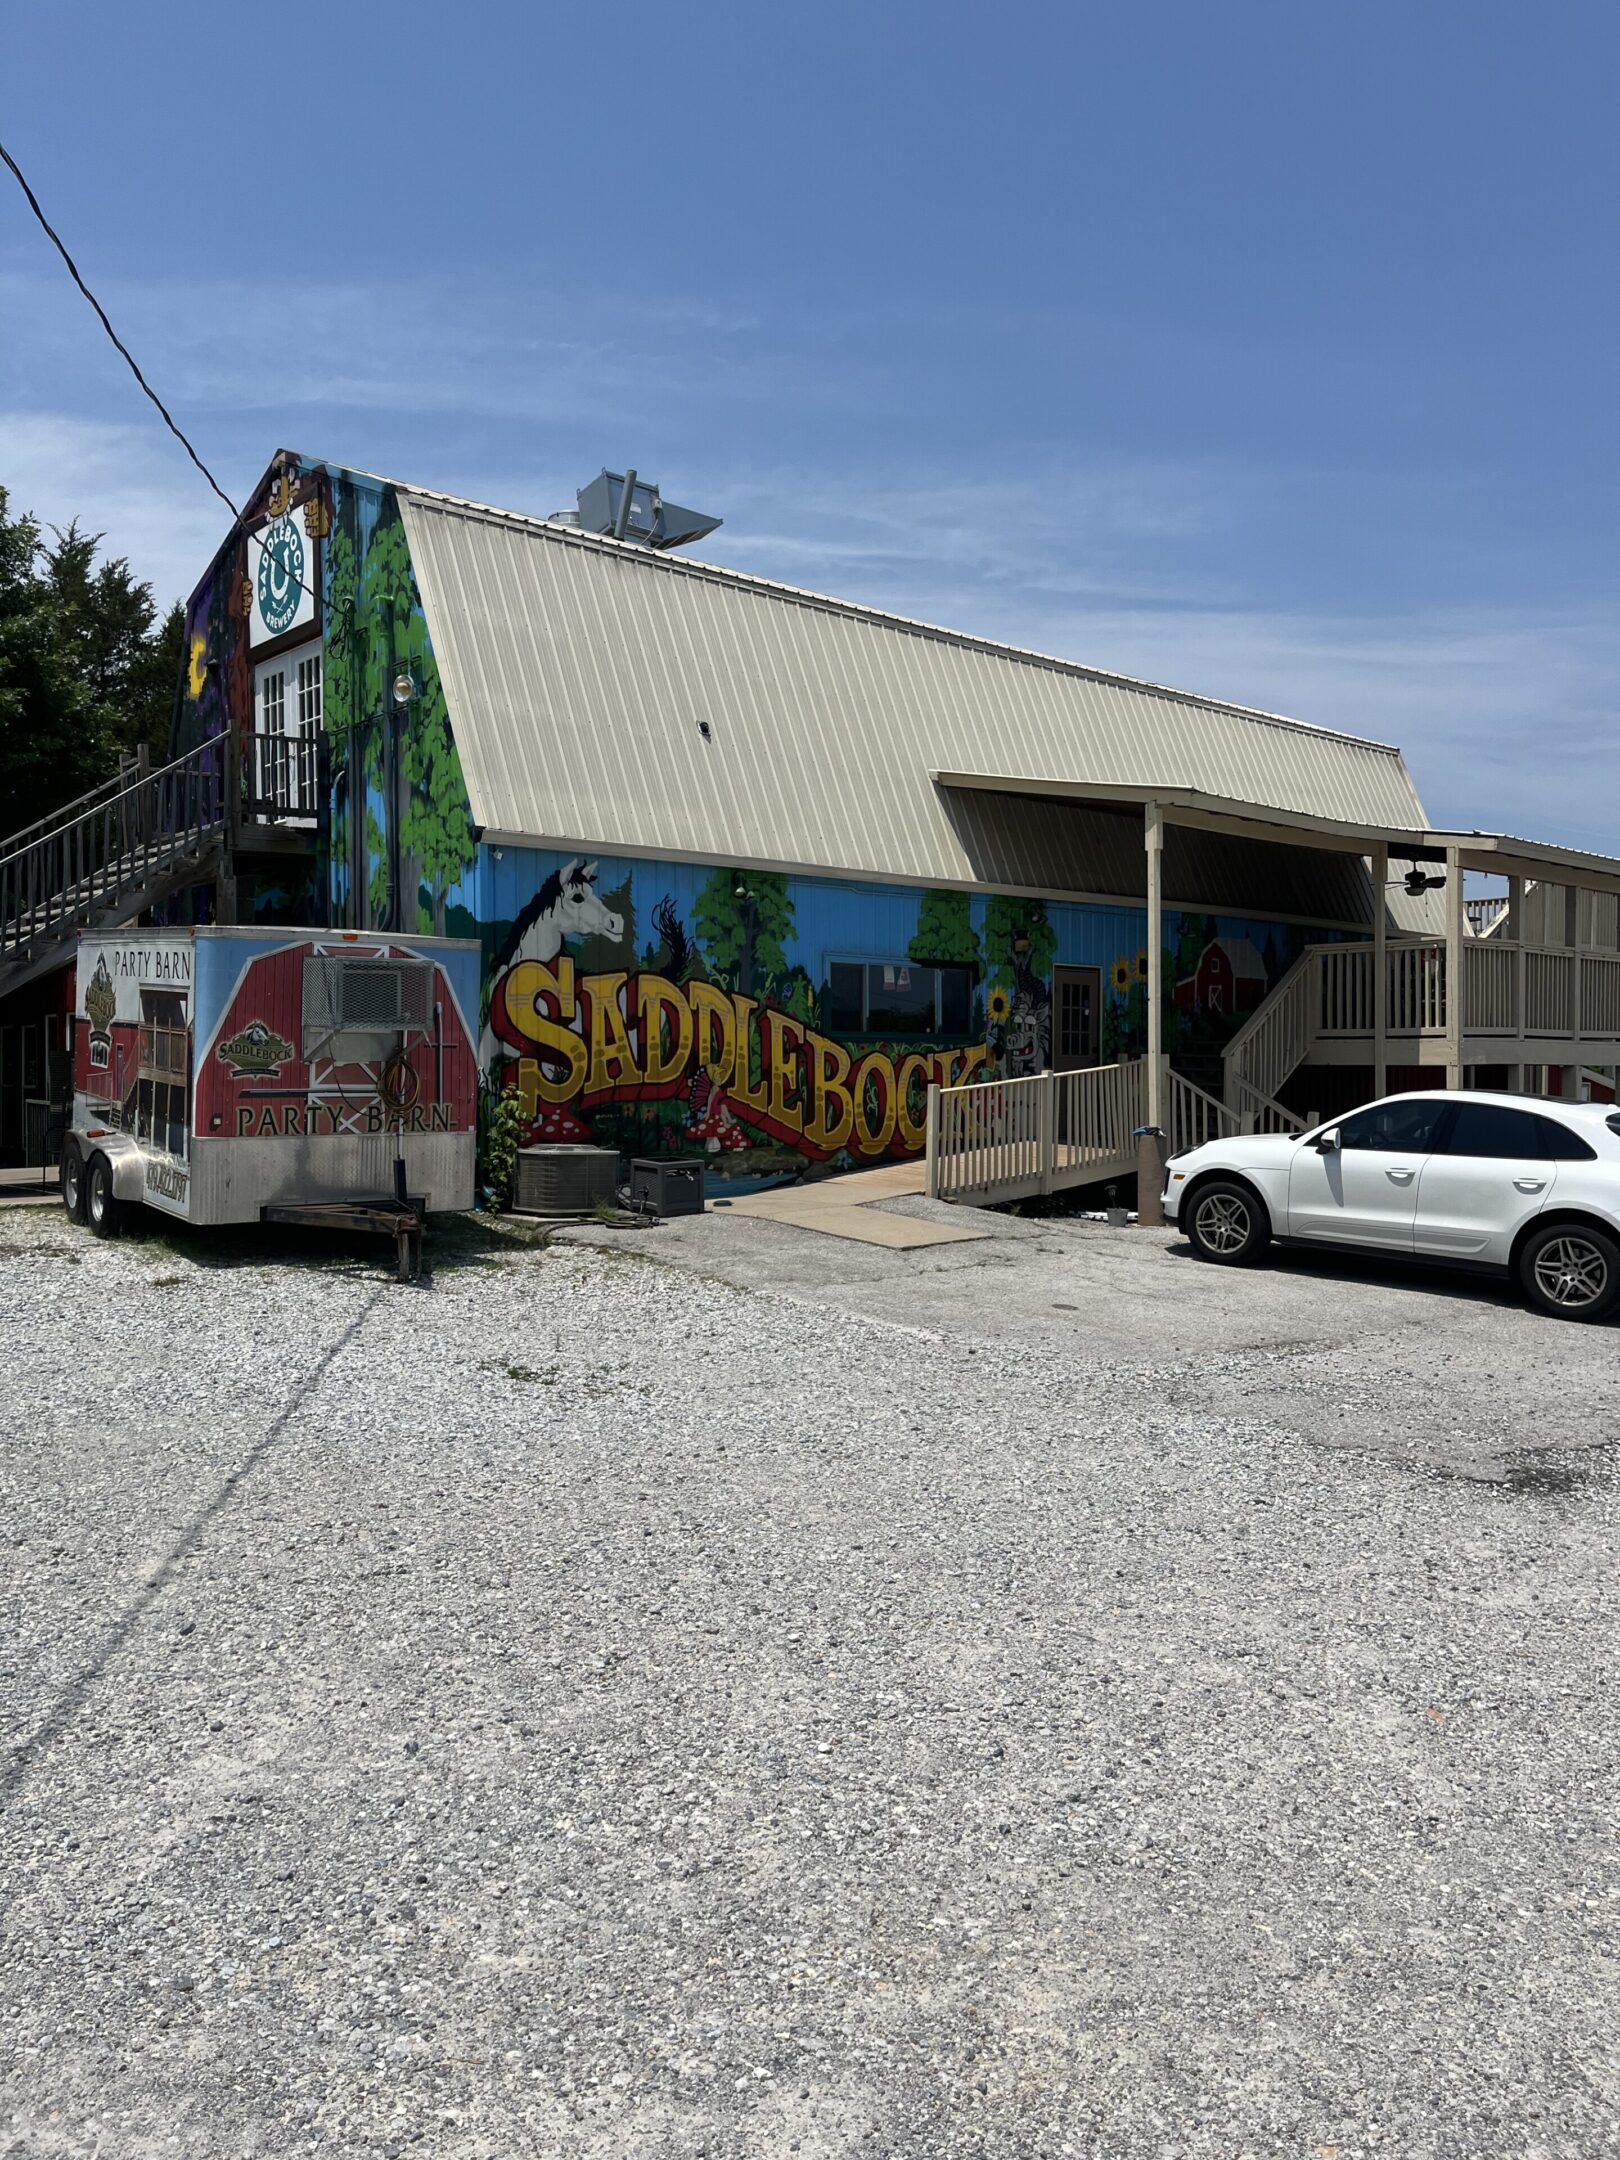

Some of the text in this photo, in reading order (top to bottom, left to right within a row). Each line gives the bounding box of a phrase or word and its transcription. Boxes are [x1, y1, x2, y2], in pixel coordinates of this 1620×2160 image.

[259, 525, 302, 601] SADDLEBOCK
[265, 599, 296, 629] BREWERY
[114, 950, 191, 980] PARTY BARN
[218, 1042, 293, 1061] SADDLEBOCK
[500, 956, 1000, 1156] SADDLEBOCK
[236, 1104, 451, 1135] PARTY BARN
